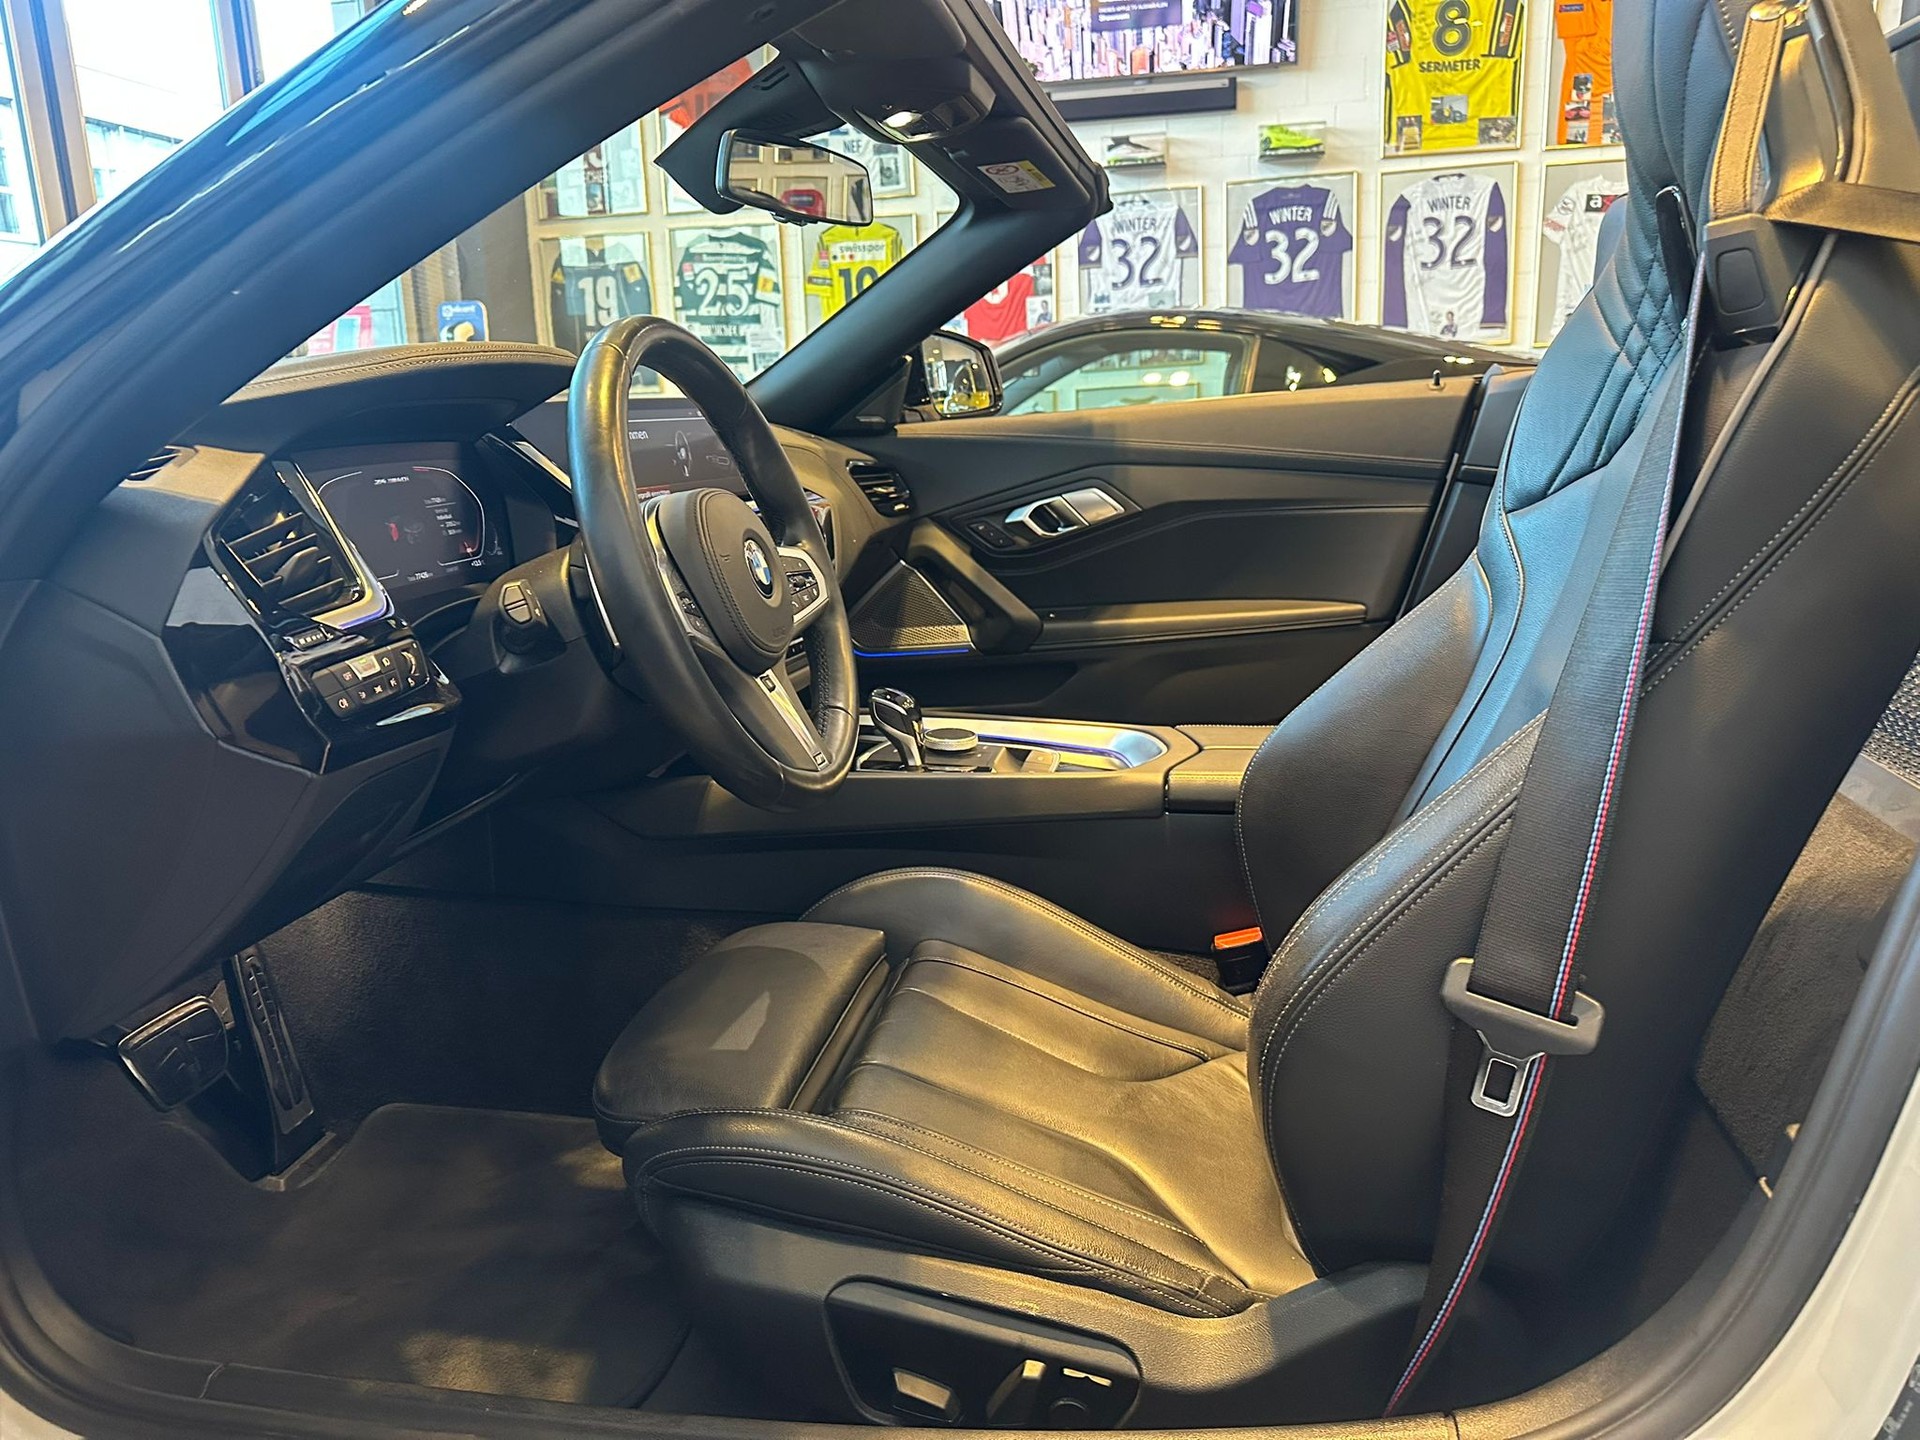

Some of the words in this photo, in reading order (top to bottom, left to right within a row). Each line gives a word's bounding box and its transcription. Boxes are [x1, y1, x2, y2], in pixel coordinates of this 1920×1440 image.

[1432, 0, 1471, 56] 8
[1419, 59, 1481, 73] SERMETER
[1113, 217, 1157, 234] WINTER
[1269, 205, 1312, 225] WINTER
[1427, 195, 1471, 212] WINTER
[1112, 236, 1164, 290] 32
[1264, 227, 1320, 285] 32
[1421, 215, 1477, 270] 32
[578, 275, 620, 327] 19
[695, 267, 749, 316] 25
